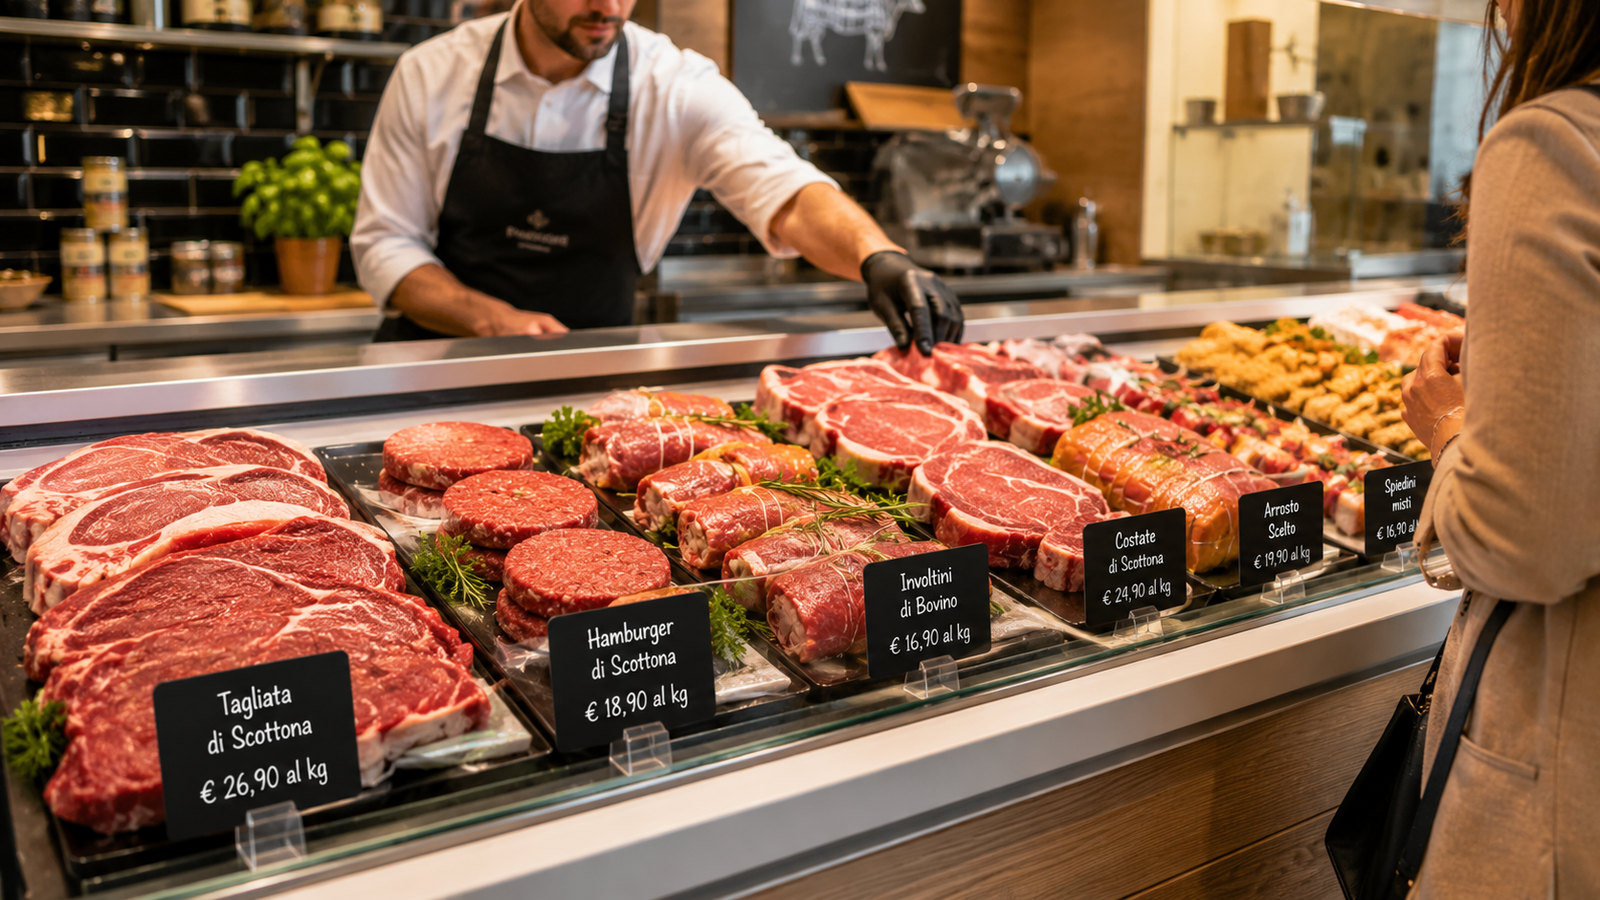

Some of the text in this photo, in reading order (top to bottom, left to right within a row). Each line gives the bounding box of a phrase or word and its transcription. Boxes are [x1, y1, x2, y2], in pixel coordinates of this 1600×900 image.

[1385, 476, 1416, 497] Spiedini
[1264, 500, 1299, 518] Arrosto
[1391, 495, 1411, 511] misti
[1116, 530, 1155, 549] Costate
[1269, 521, 1295, 539] Scelto
[1376, 526, 1384, 541] €
[1387, 522, 1406, 538] 16,90
[1408, 519, 1416, 535] al
[1109, 554, 1163, 573] di Scottona
[1253, 544, 1311, 570] € 19,90 al kg
[900, 567, 952, 591] Involtini
[1103, 578, 1171, 605] € 24,90 al kg
[901, 595, 957, 618] di Bovino
[588, 622, 674, 649] Hamburger
[890, 623, 970, 654] € 16,90 al kg
[592, 652, 676, 680] di Scottona
[217, 685, 292, 720] Tagliata
[585, 683, 688, 722] € 18,90 al kg
[208, 719, 312, 754] di Scottona
[200, 757, 328, 804] € 26,90 al kg
